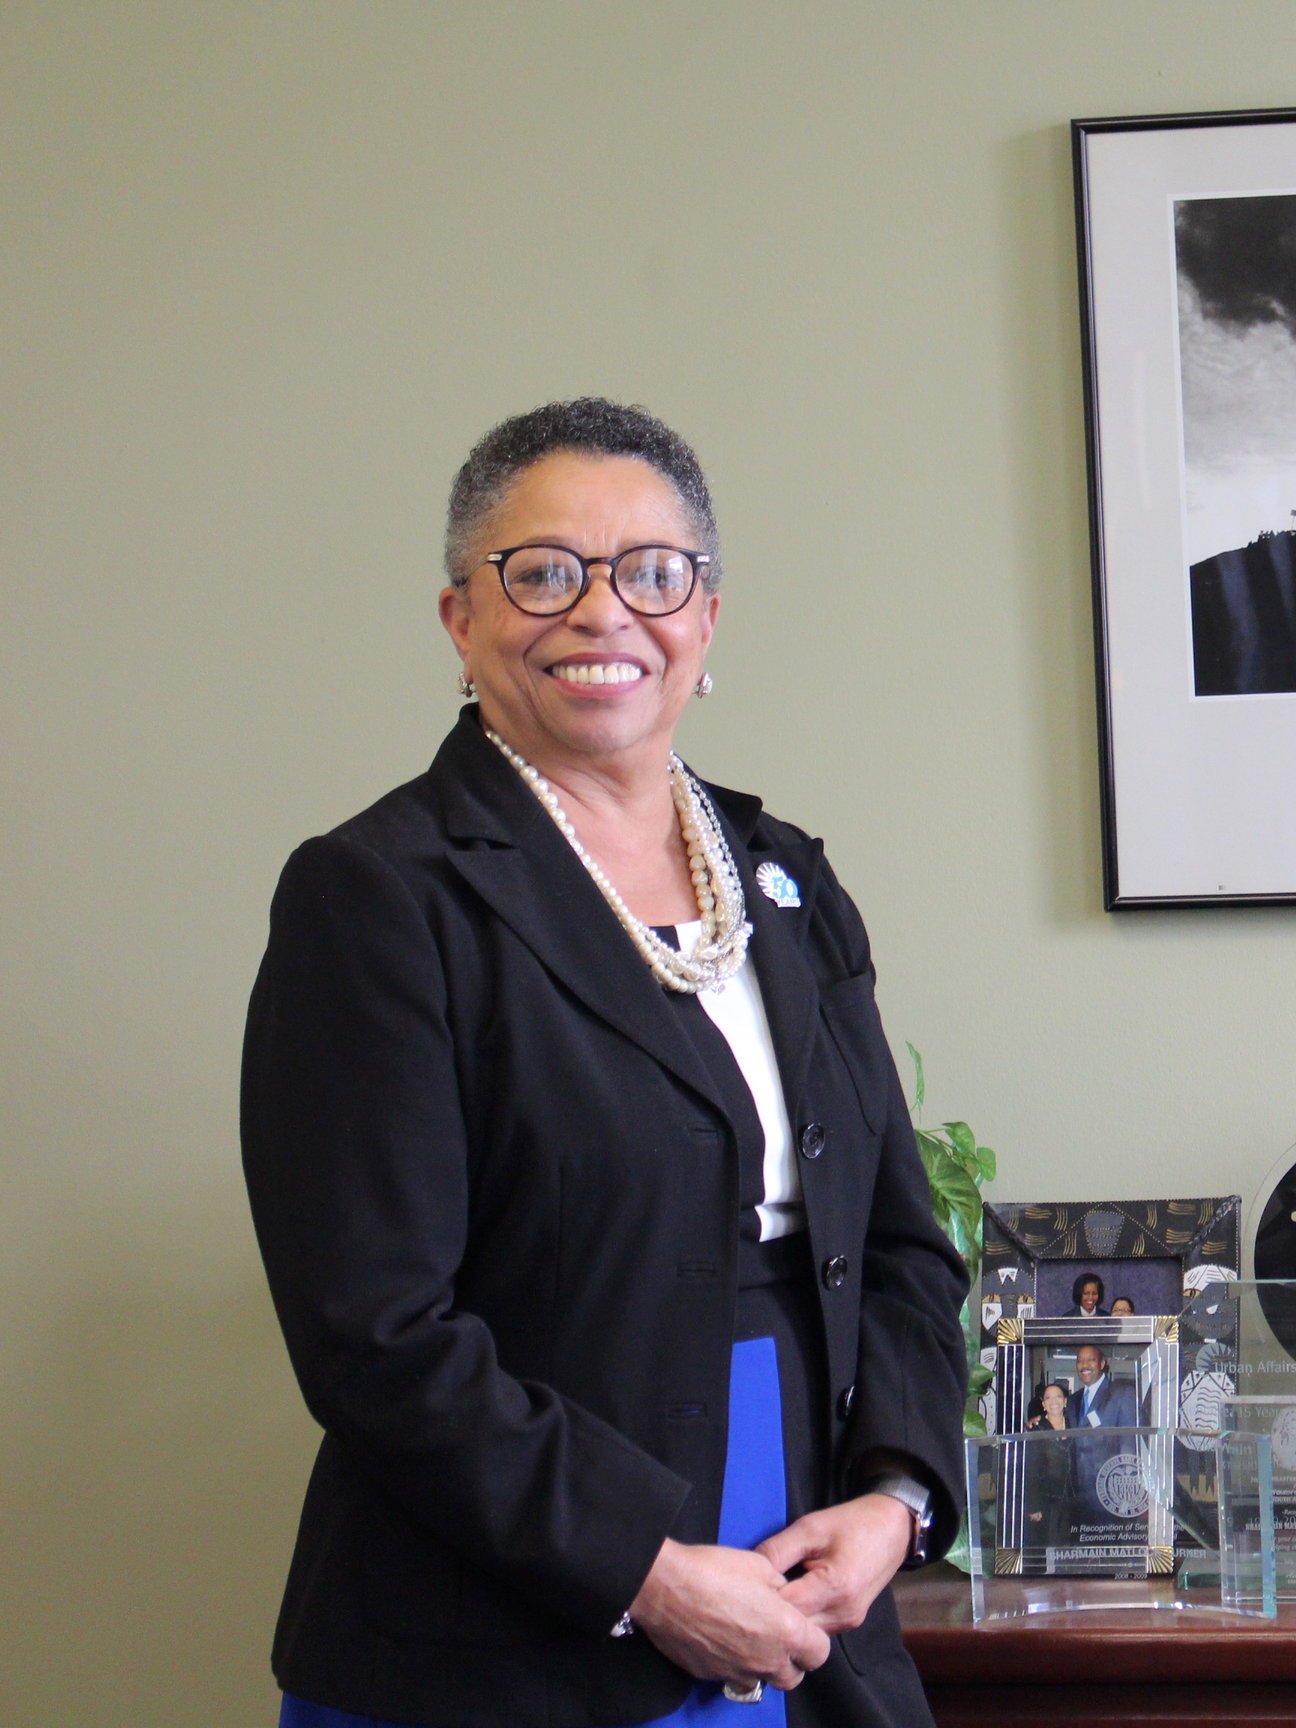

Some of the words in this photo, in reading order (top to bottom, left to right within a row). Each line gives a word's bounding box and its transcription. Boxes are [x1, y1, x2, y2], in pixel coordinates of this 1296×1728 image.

[1214, 1361, 1252, 1373] Urban
[1070, 1525, 1078, 1534] In
[1079, 1523, 1124, 1534] Recognition
[1125, 1523, 1133, 1531] of
[1079, 1532, 1117, 1542] Economic
[1117, 1531, 1148, 1542] Advisory
[1052, 1548, 1107, 1561] SHARMAIN
